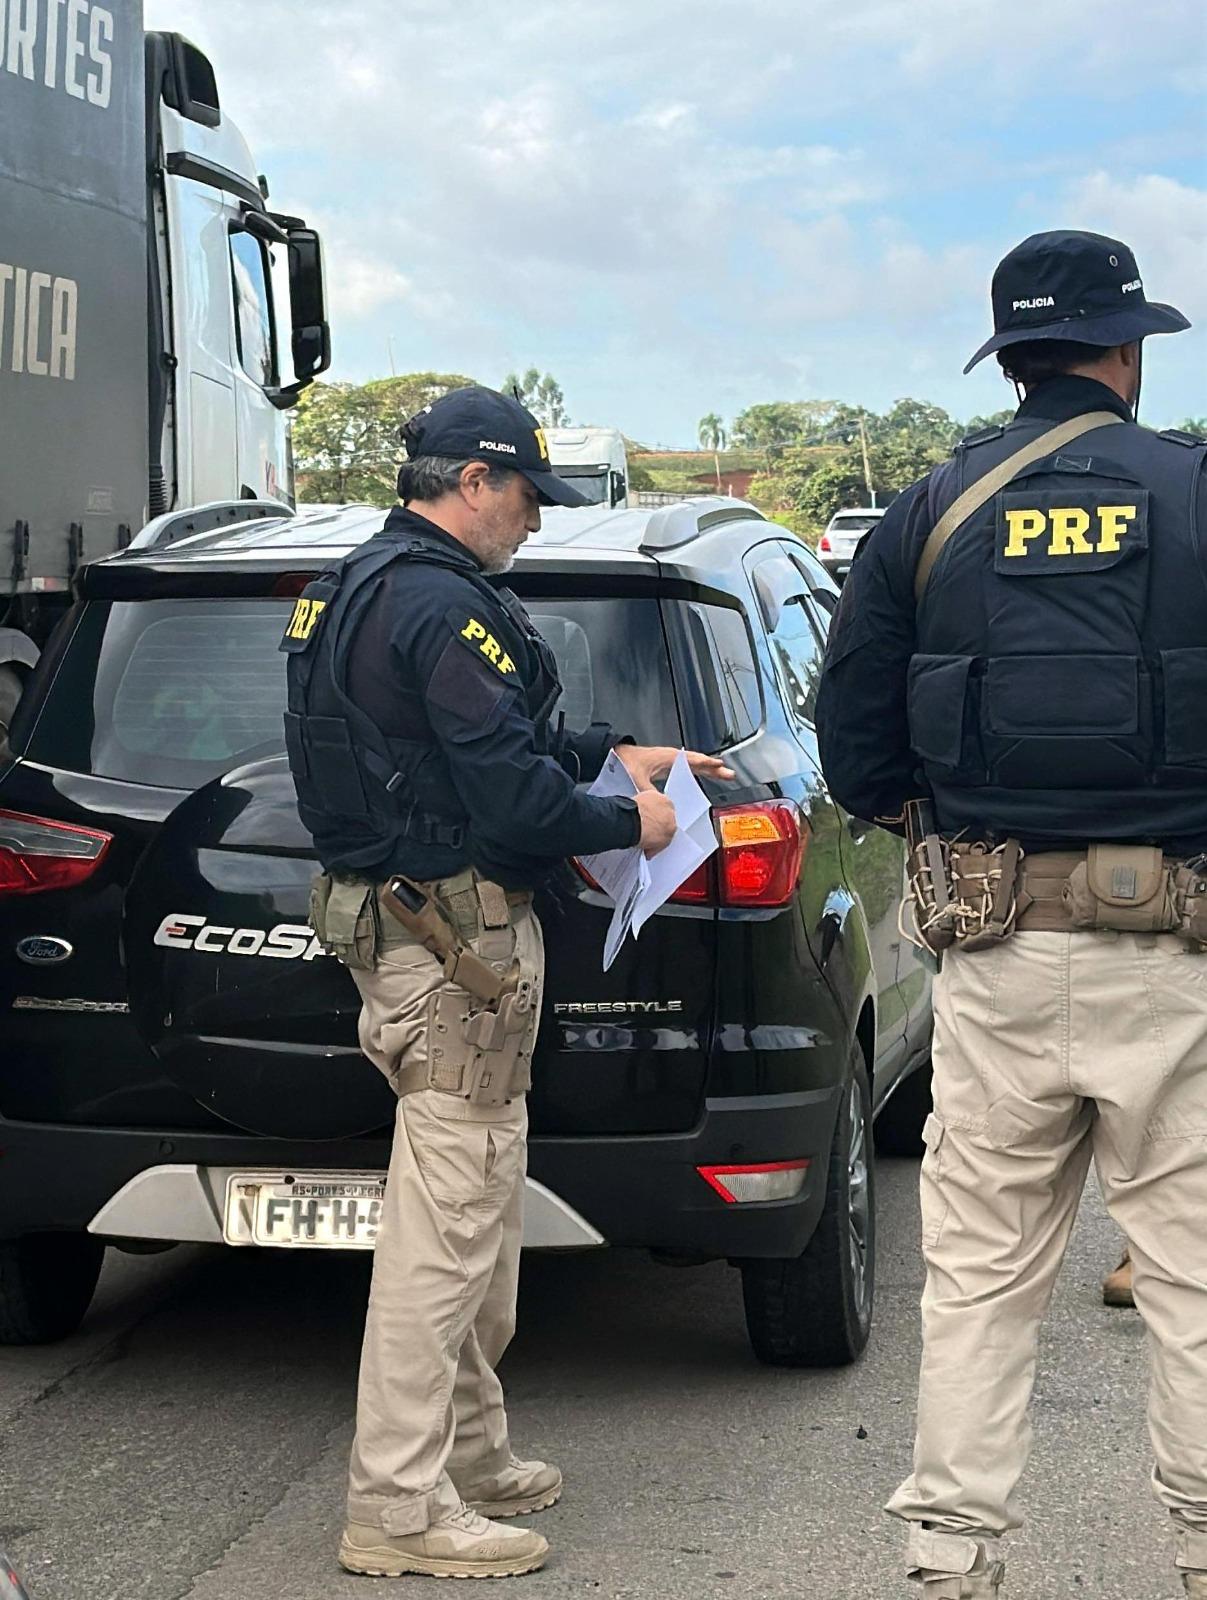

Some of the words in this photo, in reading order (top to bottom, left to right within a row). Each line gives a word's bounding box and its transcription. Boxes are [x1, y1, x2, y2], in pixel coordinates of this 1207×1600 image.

[1003, 505, 1136, 557] PRF
[461, 618, 517, 674] PRF
[554, 1000, 682, 1014] FREESTYLE
